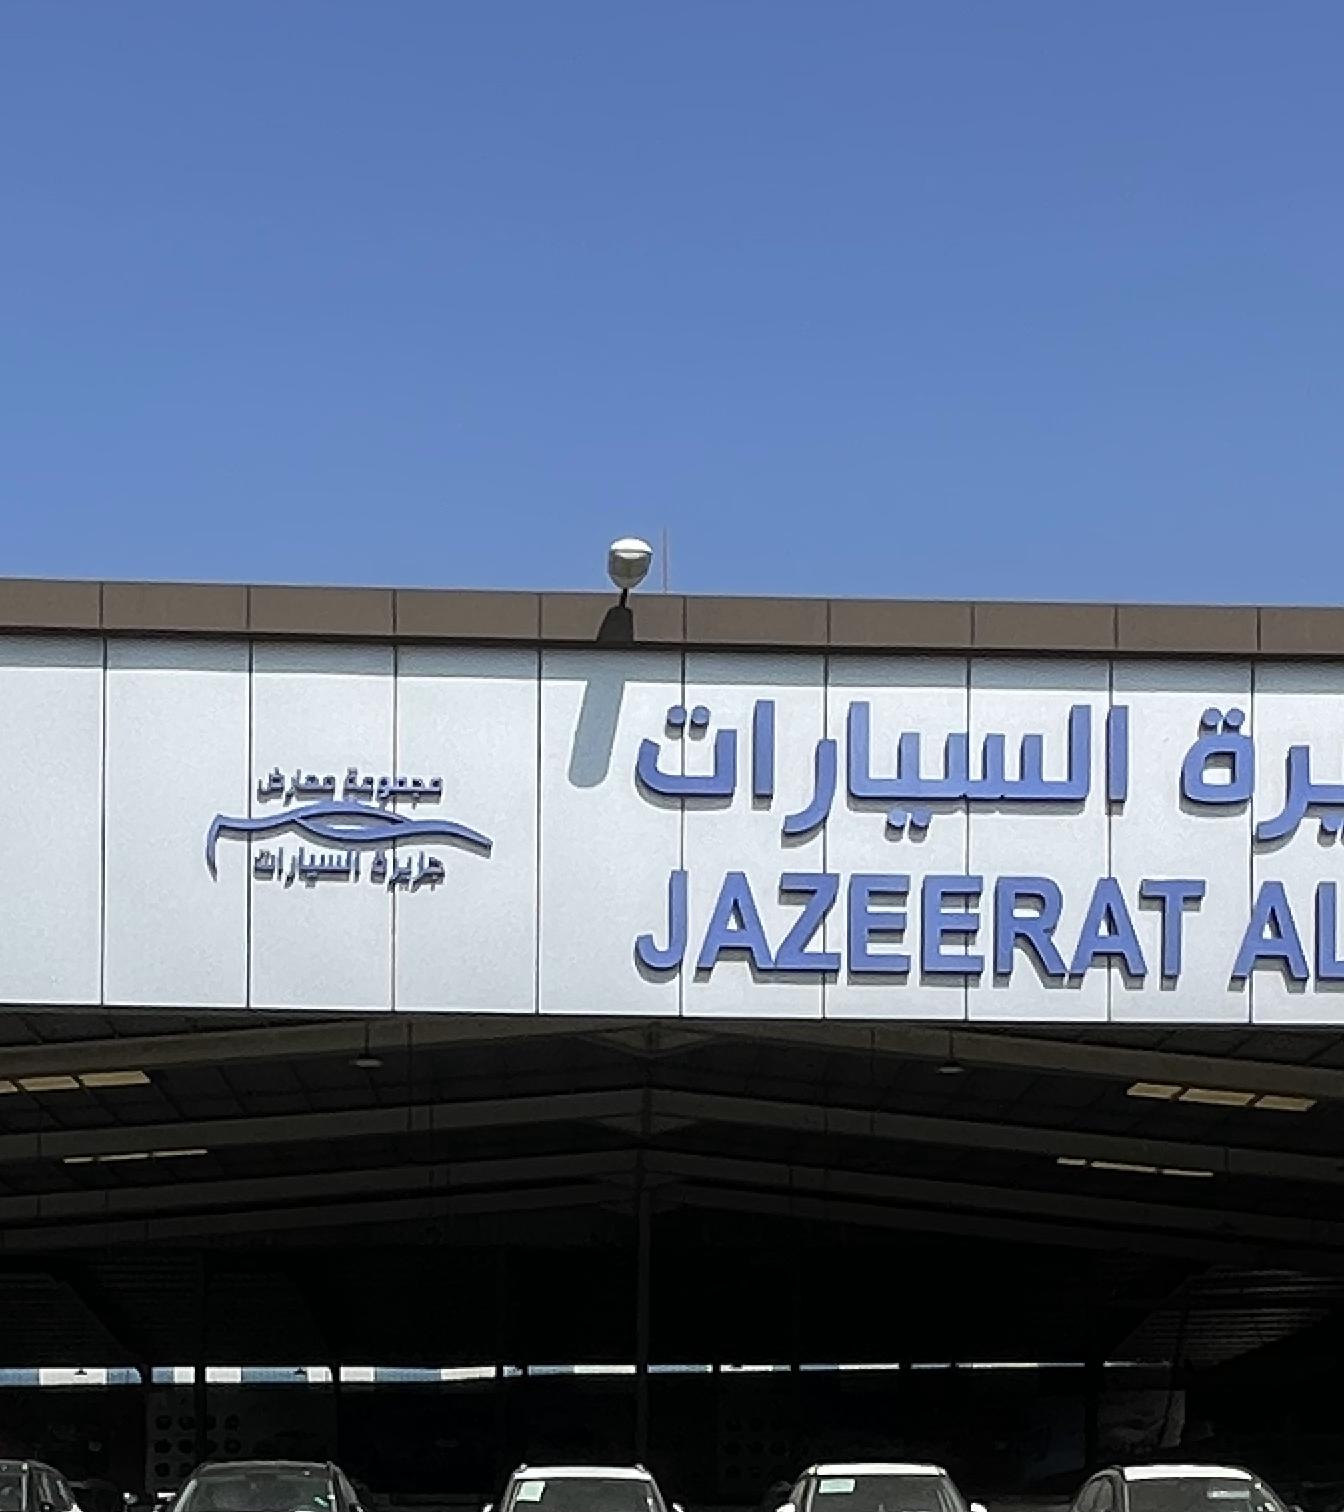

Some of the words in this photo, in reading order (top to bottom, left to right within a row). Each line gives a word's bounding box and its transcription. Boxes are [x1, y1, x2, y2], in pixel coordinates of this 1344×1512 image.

[257, 767, 335, 804] معارض
[342, 767, 444, 808] مجموعة
[635, 698, 1129, 836] السيارات
[254, 847, 360, 887] السيارات
[370, 850, 445, 892] جزيرة
[635, 870, 1205, 977] JAZEERAT
